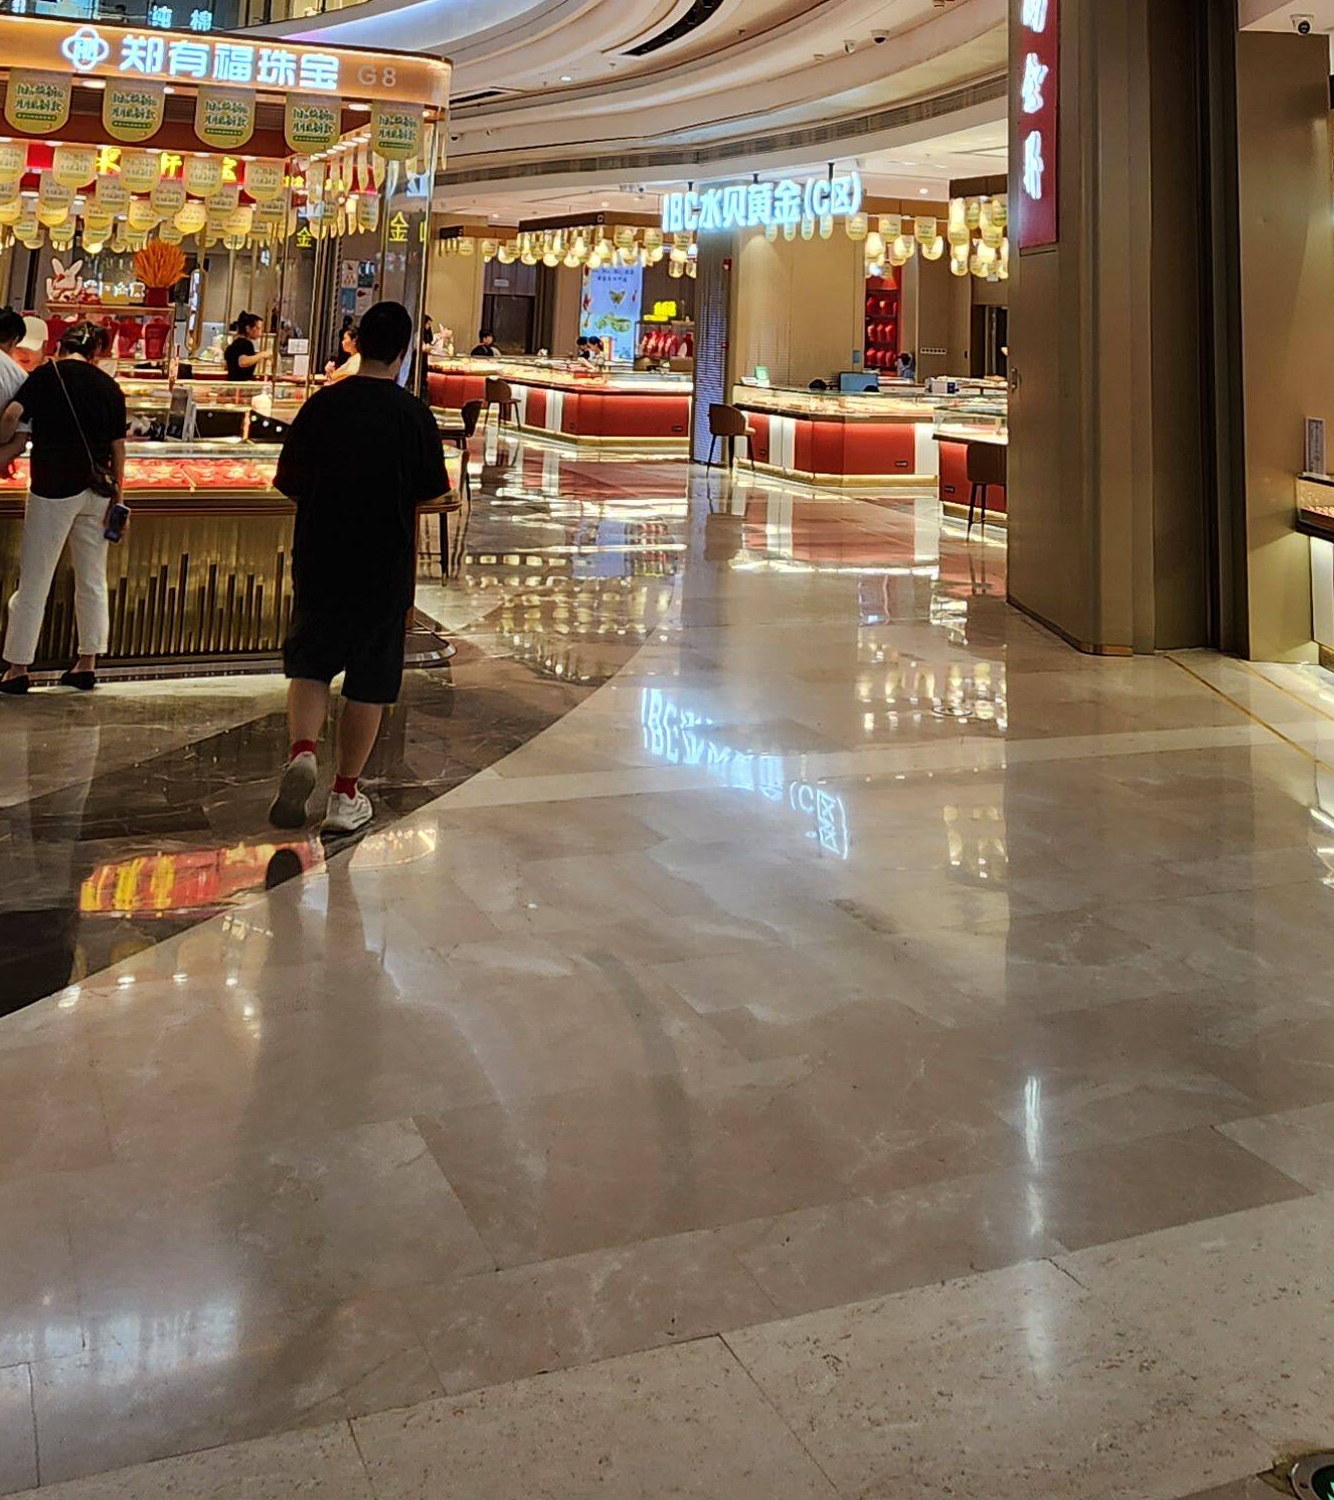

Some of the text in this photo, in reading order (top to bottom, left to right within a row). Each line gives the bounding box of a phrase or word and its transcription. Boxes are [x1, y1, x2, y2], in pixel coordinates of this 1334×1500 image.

[119, 34, 341, 90] 郑有福珠宝
[357, 65, 397, 88] G8
[662, 171, 862, 233] IBC水贝黄金(C区)
